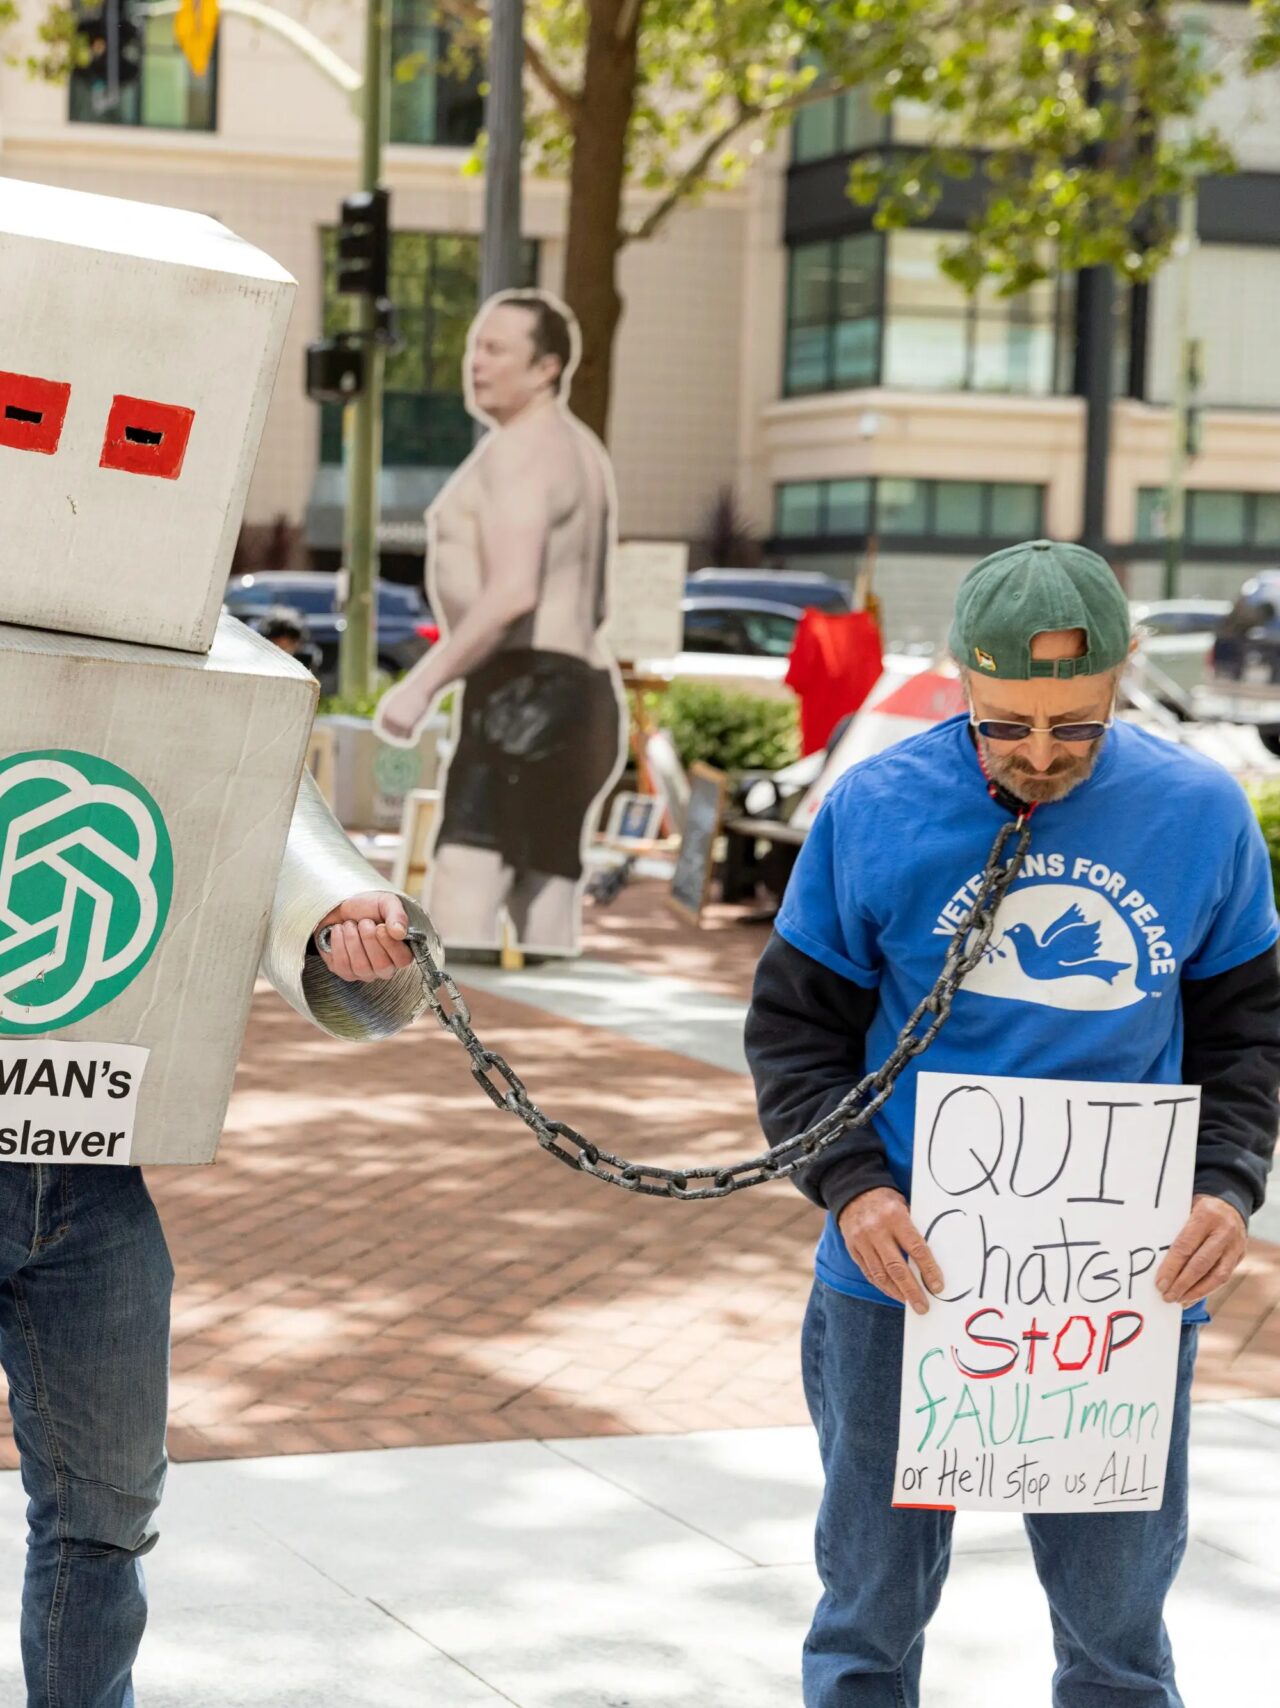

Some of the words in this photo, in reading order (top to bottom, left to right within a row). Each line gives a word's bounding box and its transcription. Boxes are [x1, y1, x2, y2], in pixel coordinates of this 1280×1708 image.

[1071, 857, 1128, 899] FOR
[1118, 889, 1177, 977] PEACE
[927, 1085, 1197, 1209] QUIT
[922, 1208, 1173, 1306] ChatGP
[901, 1464, 928, 1490] or
[1063, 1474, 1087, 1495] us
[1093, 1451, 1158, 1496] ALL
